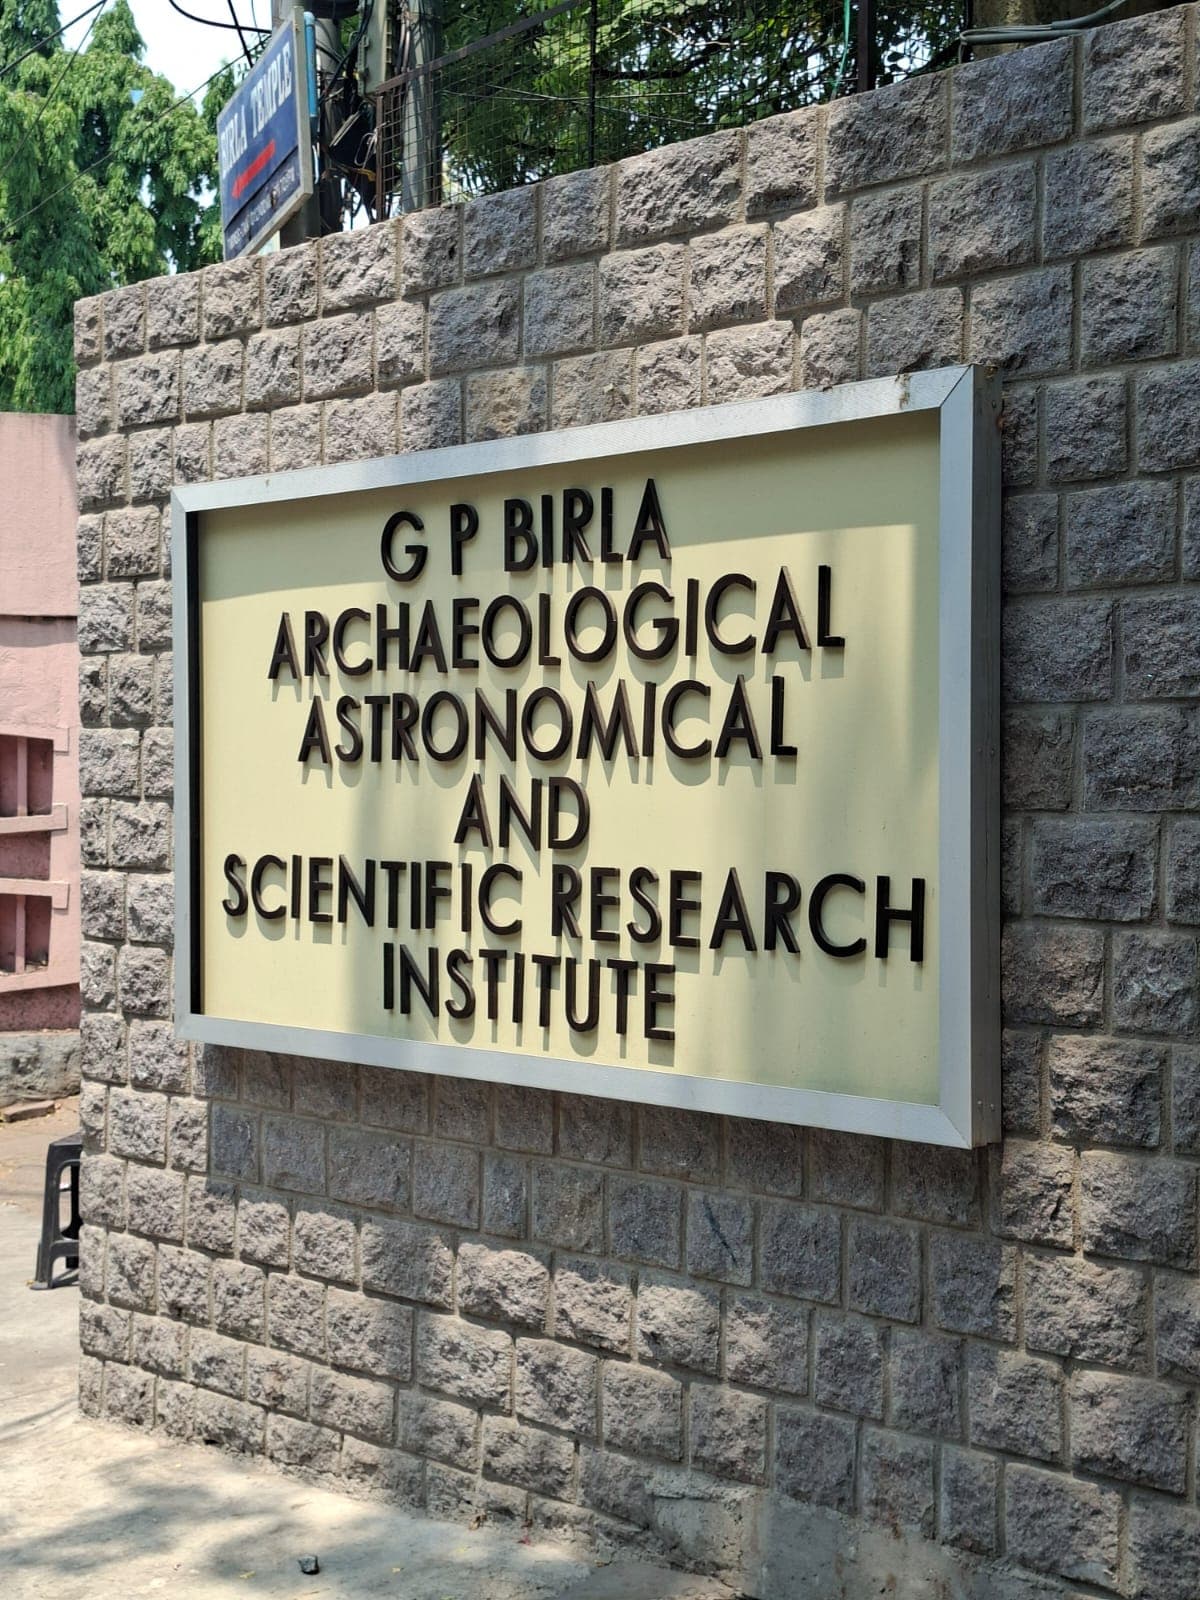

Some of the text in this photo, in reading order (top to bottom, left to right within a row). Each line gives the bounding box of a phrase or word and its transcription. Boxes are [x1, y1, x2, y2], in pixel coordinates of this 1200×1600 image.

[249, 41, 293, 138] TEMPLE
[381, 478, 671, 582] G P BIRLA
[268, 565, 846, 680] ARCHAEOLOGICAL
[298, 674, 798, 764] ASTRONOMICAL
[454, 773, 590, 852] AND
[222, 853, 925, 963] SCIENTIFIC RESEARCH
[383, 942, 676, 1041] INSTITUTE
